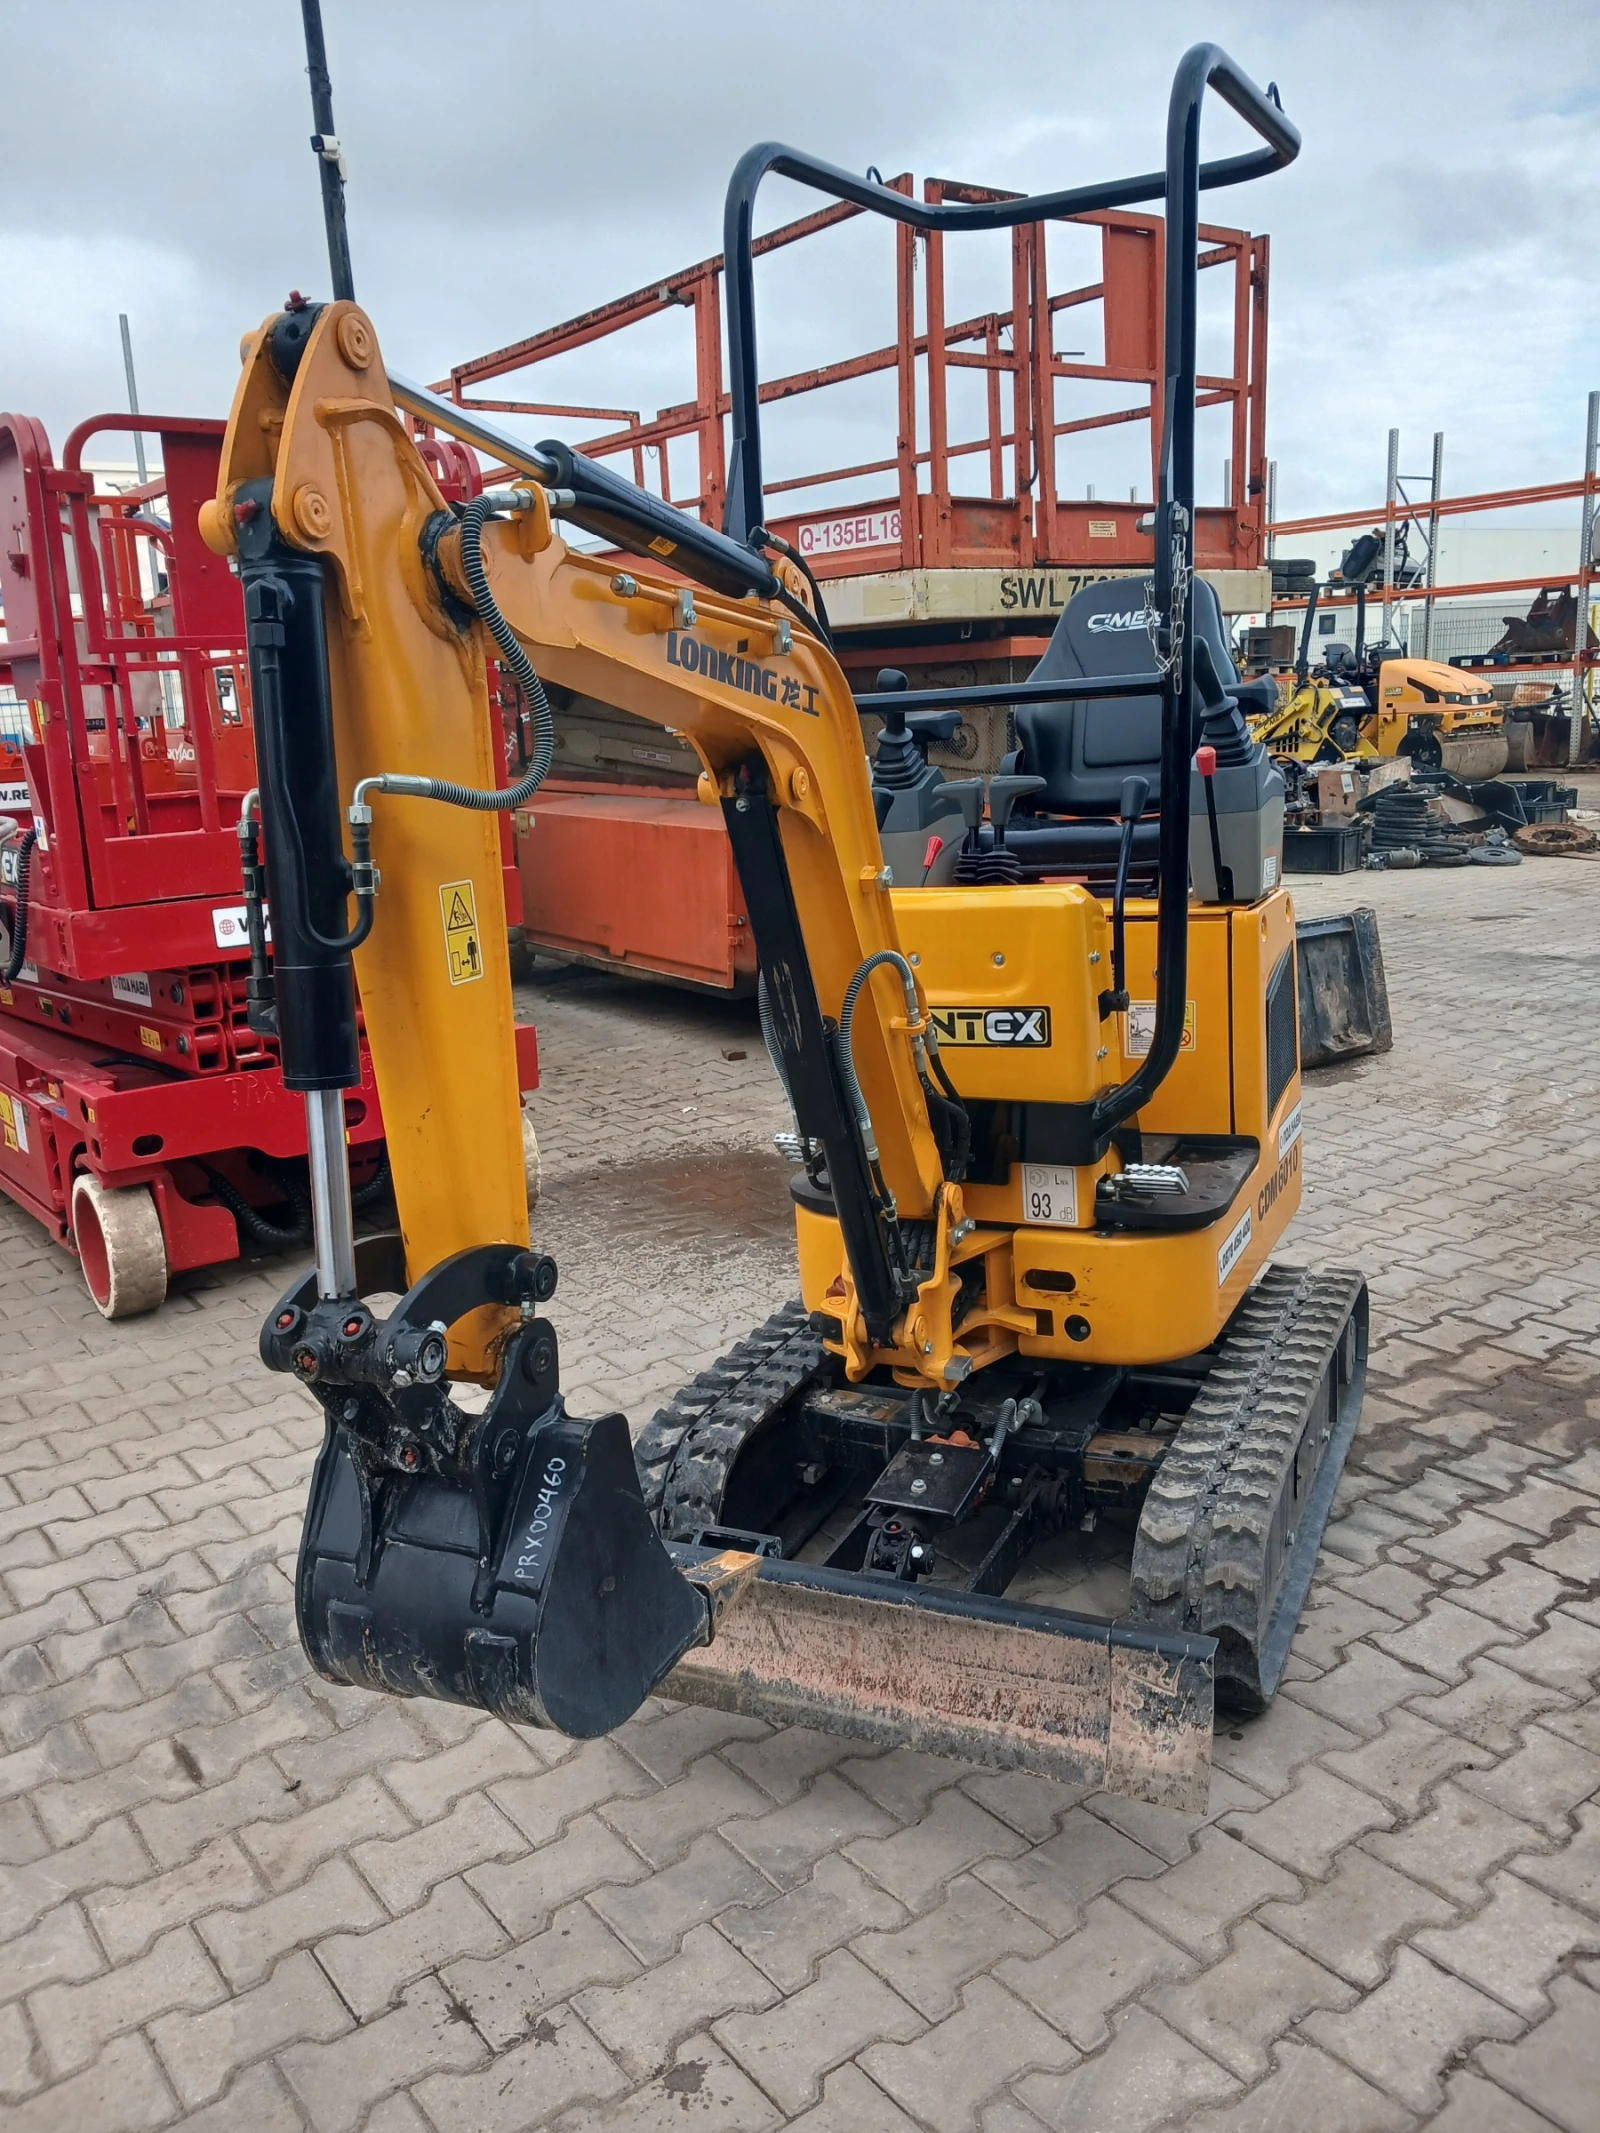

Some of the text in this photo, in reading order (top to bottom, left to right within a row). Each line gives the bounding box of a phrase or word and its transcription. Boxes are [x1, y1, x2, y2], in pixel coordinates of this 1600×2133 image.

[800, 513, 902, 551] Q-135EL18
[1000, 577, 1065, 609] SWL
[1031, 1192, 1051, 1218] 93
[1060, 1207, 1073, 1220] dB
[514, 1457, 566, 1579] PRX00460
